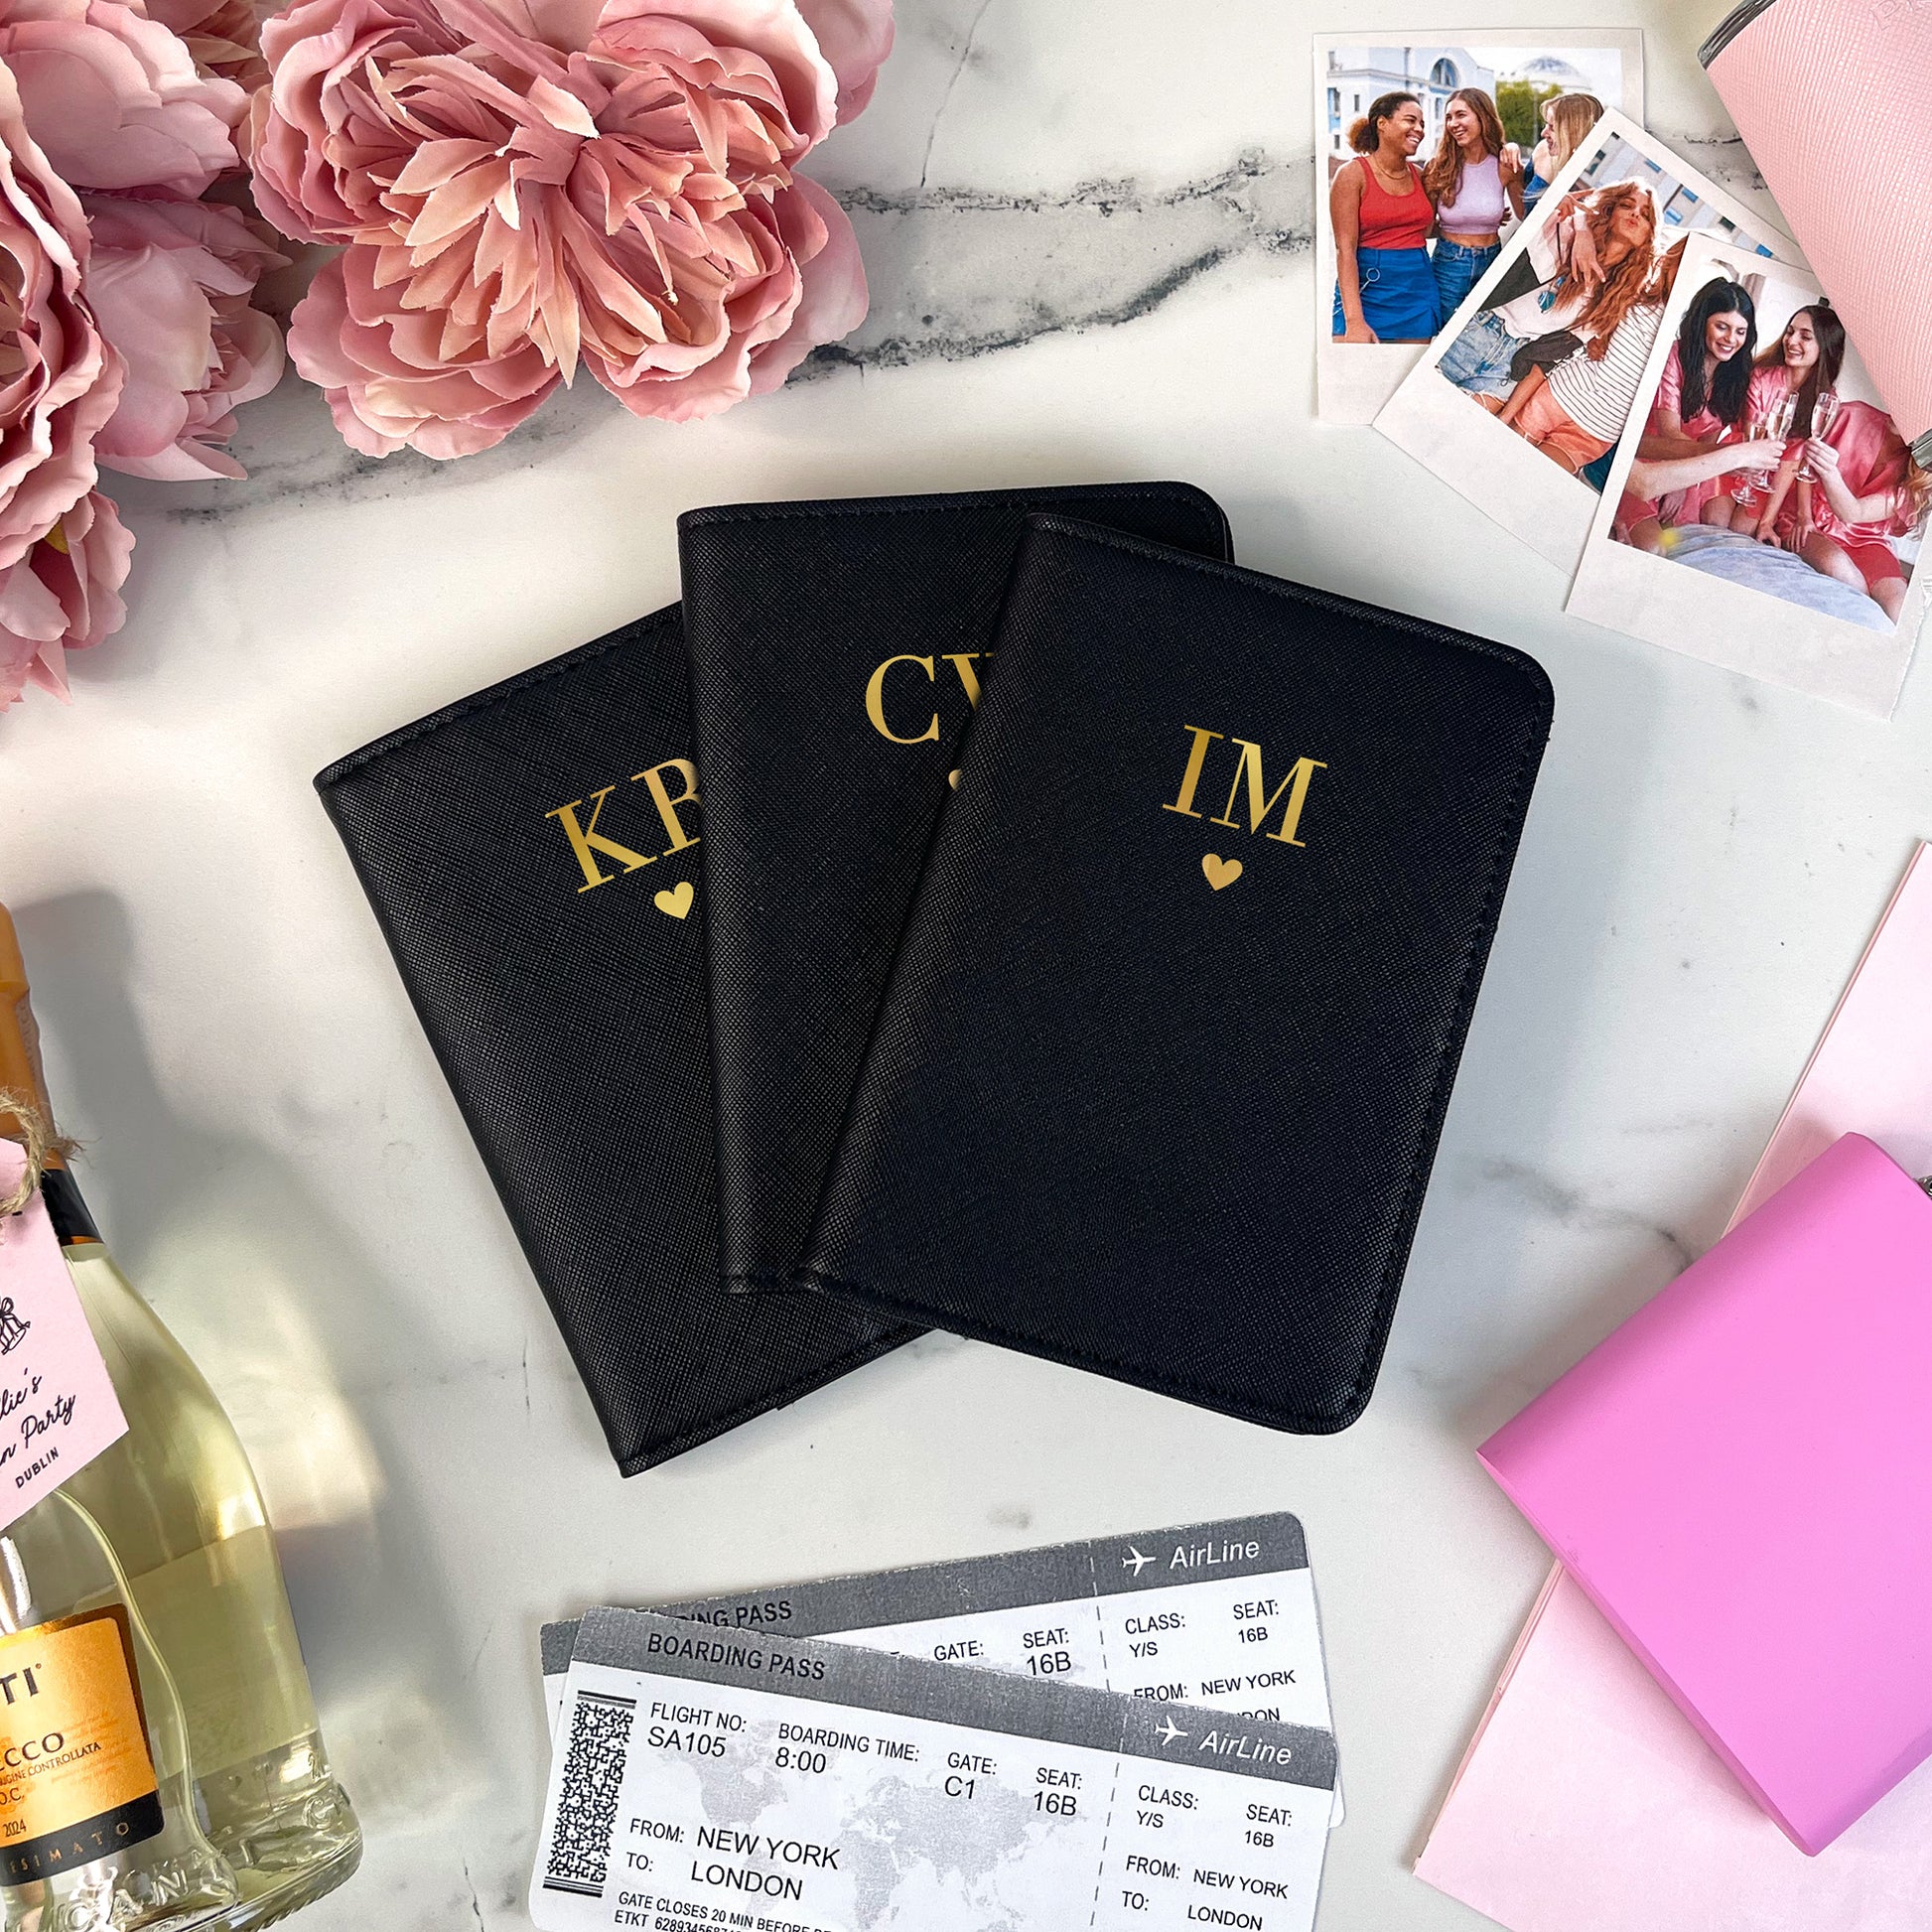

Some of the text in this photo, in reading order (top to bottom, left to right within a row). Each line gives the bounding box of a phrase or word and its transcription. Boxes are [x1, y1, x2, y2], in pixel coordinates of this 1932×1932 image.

[1163, 725, 1328, 848] IM
[21, 1395, 75, 1449] Party
[15, 1447, 60, 1488] DUBLIN
[1170, 1539, 1260, 1570] AirLine
[737, 1600, 792, 1628] PASS
[1125, 1613, 1186, 1635] CLASS:
[1233, 1600, 1279, 1620] SEAT:
[1023, 1627, 1070, 1649] SEAT:
[1238, 1626, 1269, 1644] 16B
[647, 1633, 826, 1681] BOARDING PASS
[934, 1641, 984, 1662] GATE:
[1027, 1651, 1071, 1677] 16B
[1130, 1641, 1158, 1659] Y/S
[1134, 1670, 1297, 1702] FROM: NEW YORK
[650, 1702, 747, 1733] FLIGHT NO:
[0, 1732, 65, 1771] CCO
[647, 1726, 727, 1757] SA105
[778, 1723, 920, 1762] BOARDING TIME:
[1198, 1729, 1293, 1765] AirLine
[27, 1741, 102, 1776] CONTROLLATA
[774, 1746, 827, 1774] 8:00
[947, 1752, 998, 1775] GATE:
[944, 1775, 976, 1800] C1
[1035, 1767, 1082, 1790] SEAT:
[1034, 1791, 1077, 1817] 16B
[1138, 1785, 1198, 1810] CLASS:
[1137, 1810, 1165, 1830] Y/S
[1246, 1804, 1292, 1827] SEAT:
[629, 1818, 841, 1870] FROM: NEW YORK
[1244, 1830, 1275, 1849] 16B
[626, 1852, 803, 1900] TO: LONDON
[1126, 1856, 1289, 1900] FROM: NEW YORK
[614, 1909, 649, 1927] ETKT
[619, 1890, 653, 1909] GATE
[656, 1897, 708, 1919] CLOSES
[711, 1908, 727, 1923] 20
[729, 1912, 754, 1928] MIN
[1122, 1890, 1263, 1931] TO: LONDON
